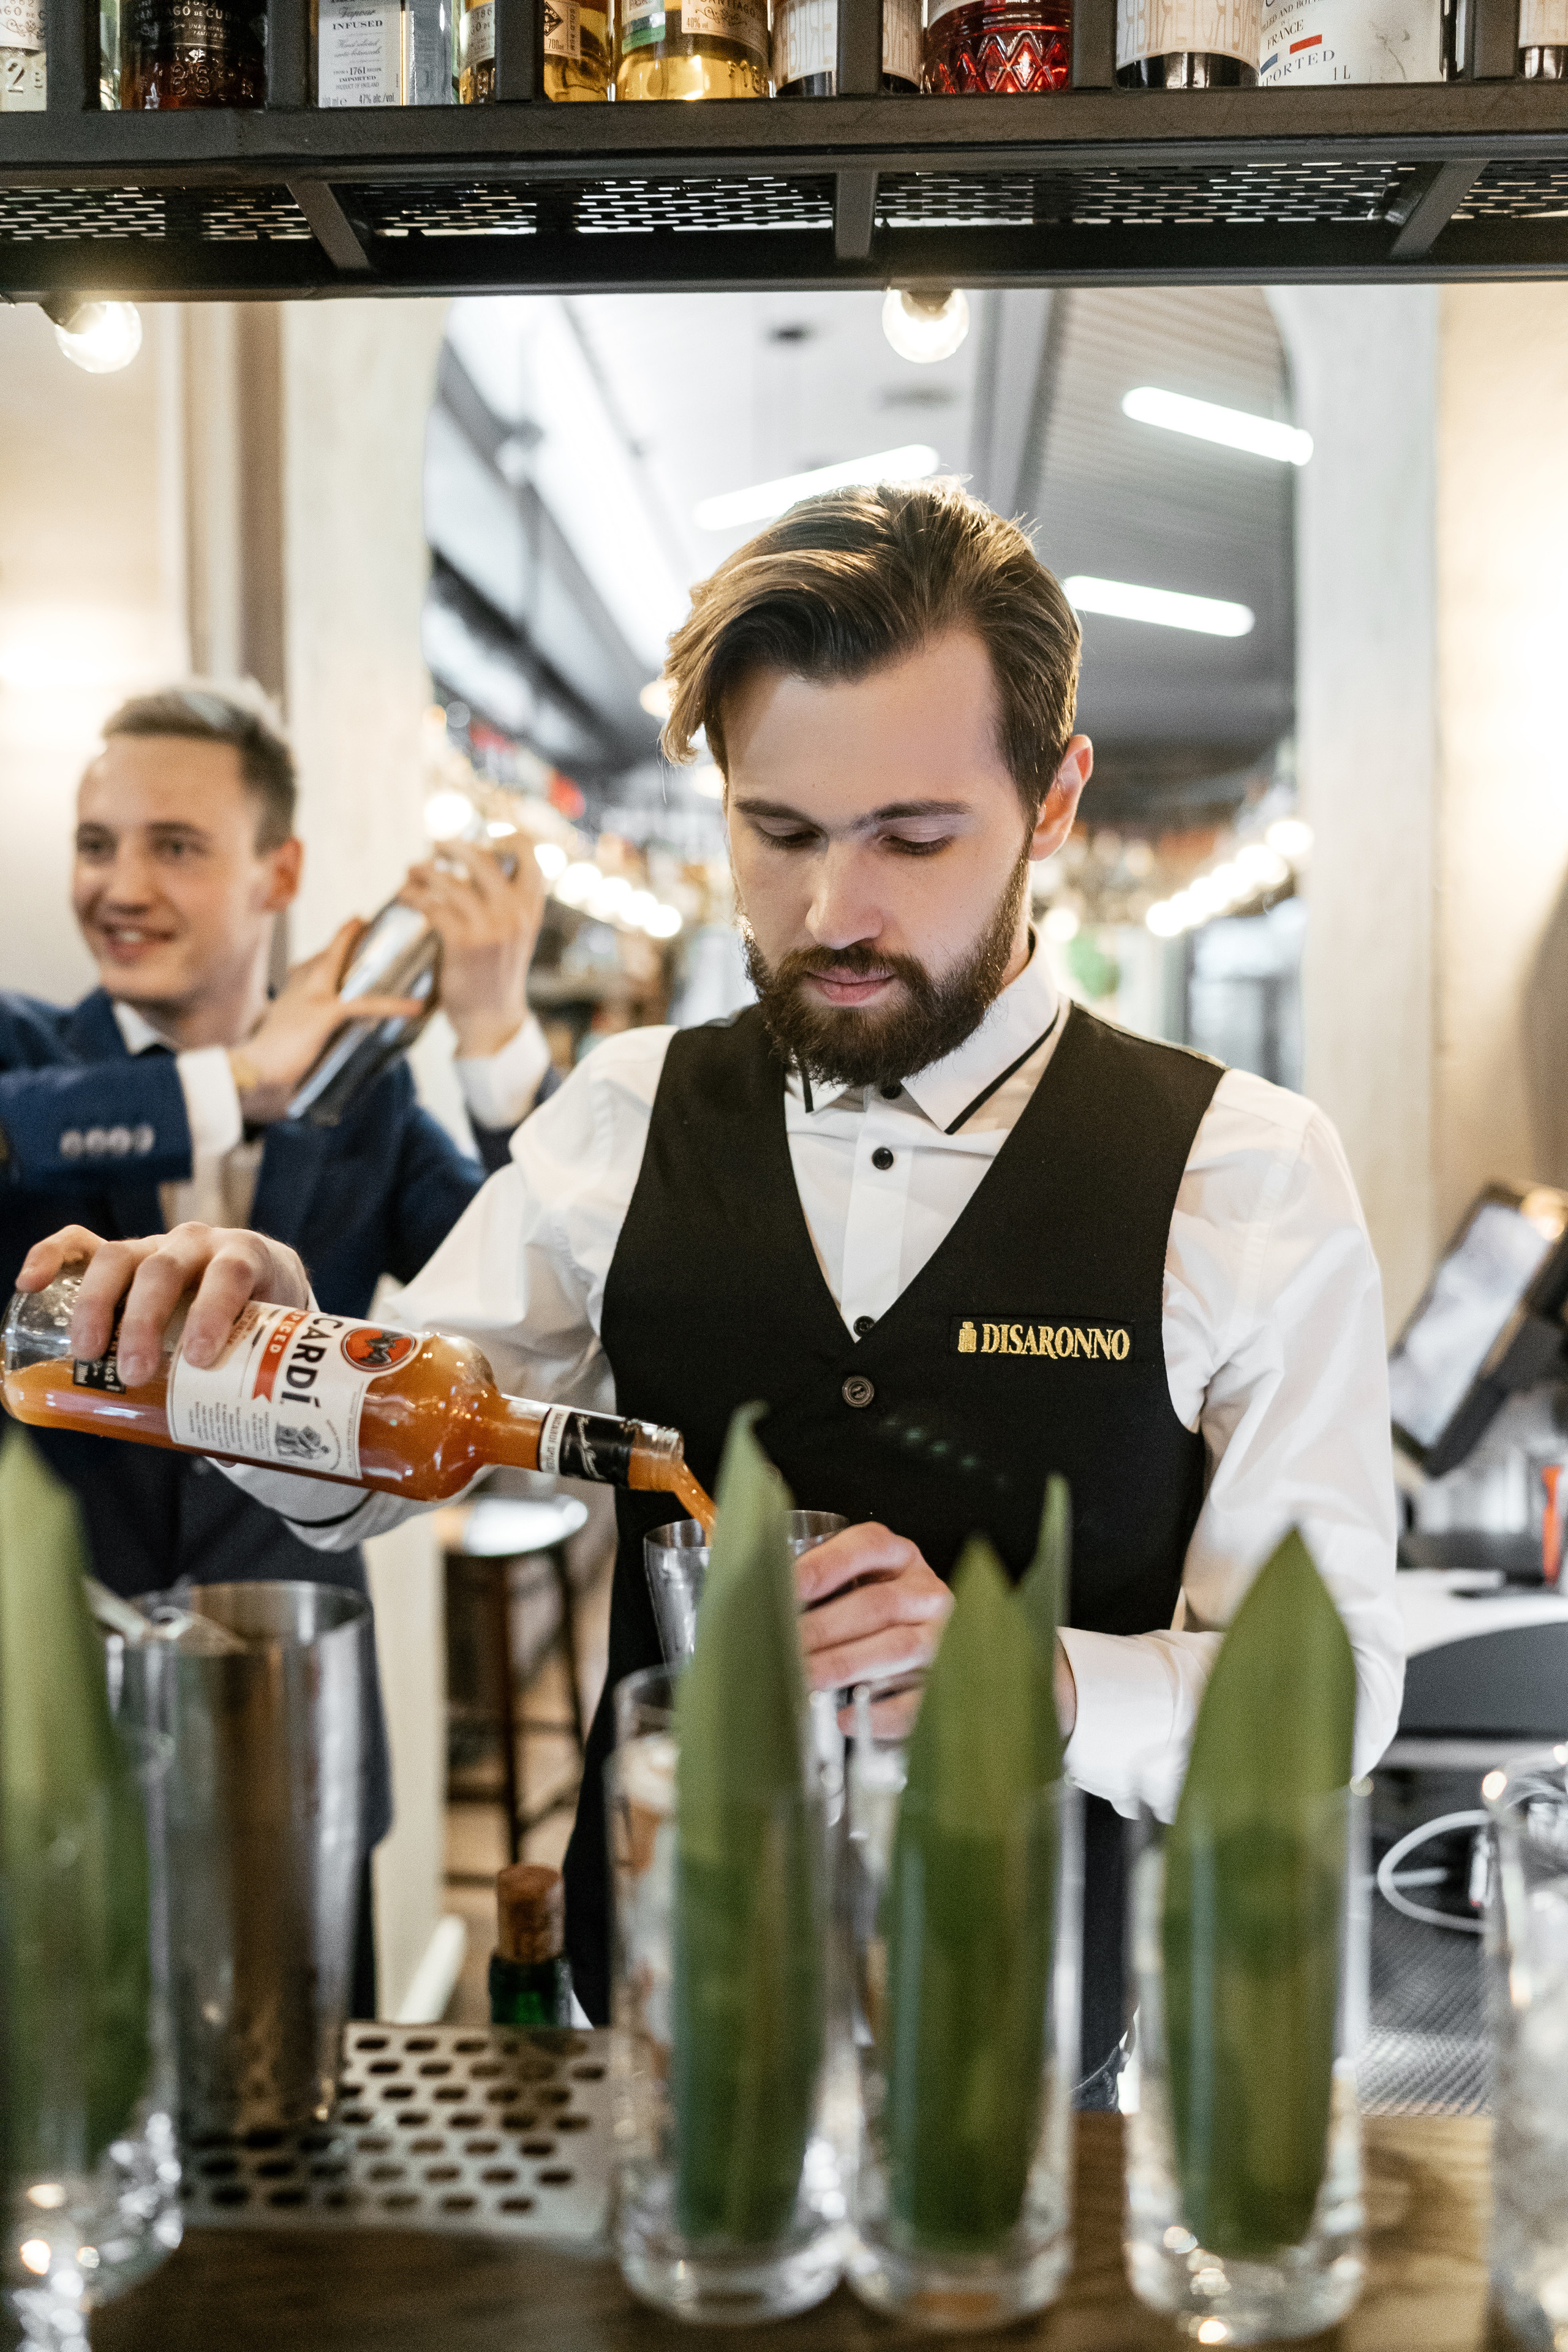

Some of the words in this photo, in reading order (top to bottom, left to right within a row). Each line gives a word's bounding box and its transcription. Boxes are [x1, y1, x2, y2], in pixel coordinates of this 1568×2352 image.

[1280, 5, 1294, 18] AND
[332, 20, 383, 29] INFUSED
[686, 17, 701, 29] 40%
[1267, 19, 1304, 50] FRANCE
[350, 67, 366, 75] 1761
[1262, 50, 1335, 86] PORTED
[359, 93, 371, 105] 47%
[981, 1323, 1130, 1360] DISARONNO
